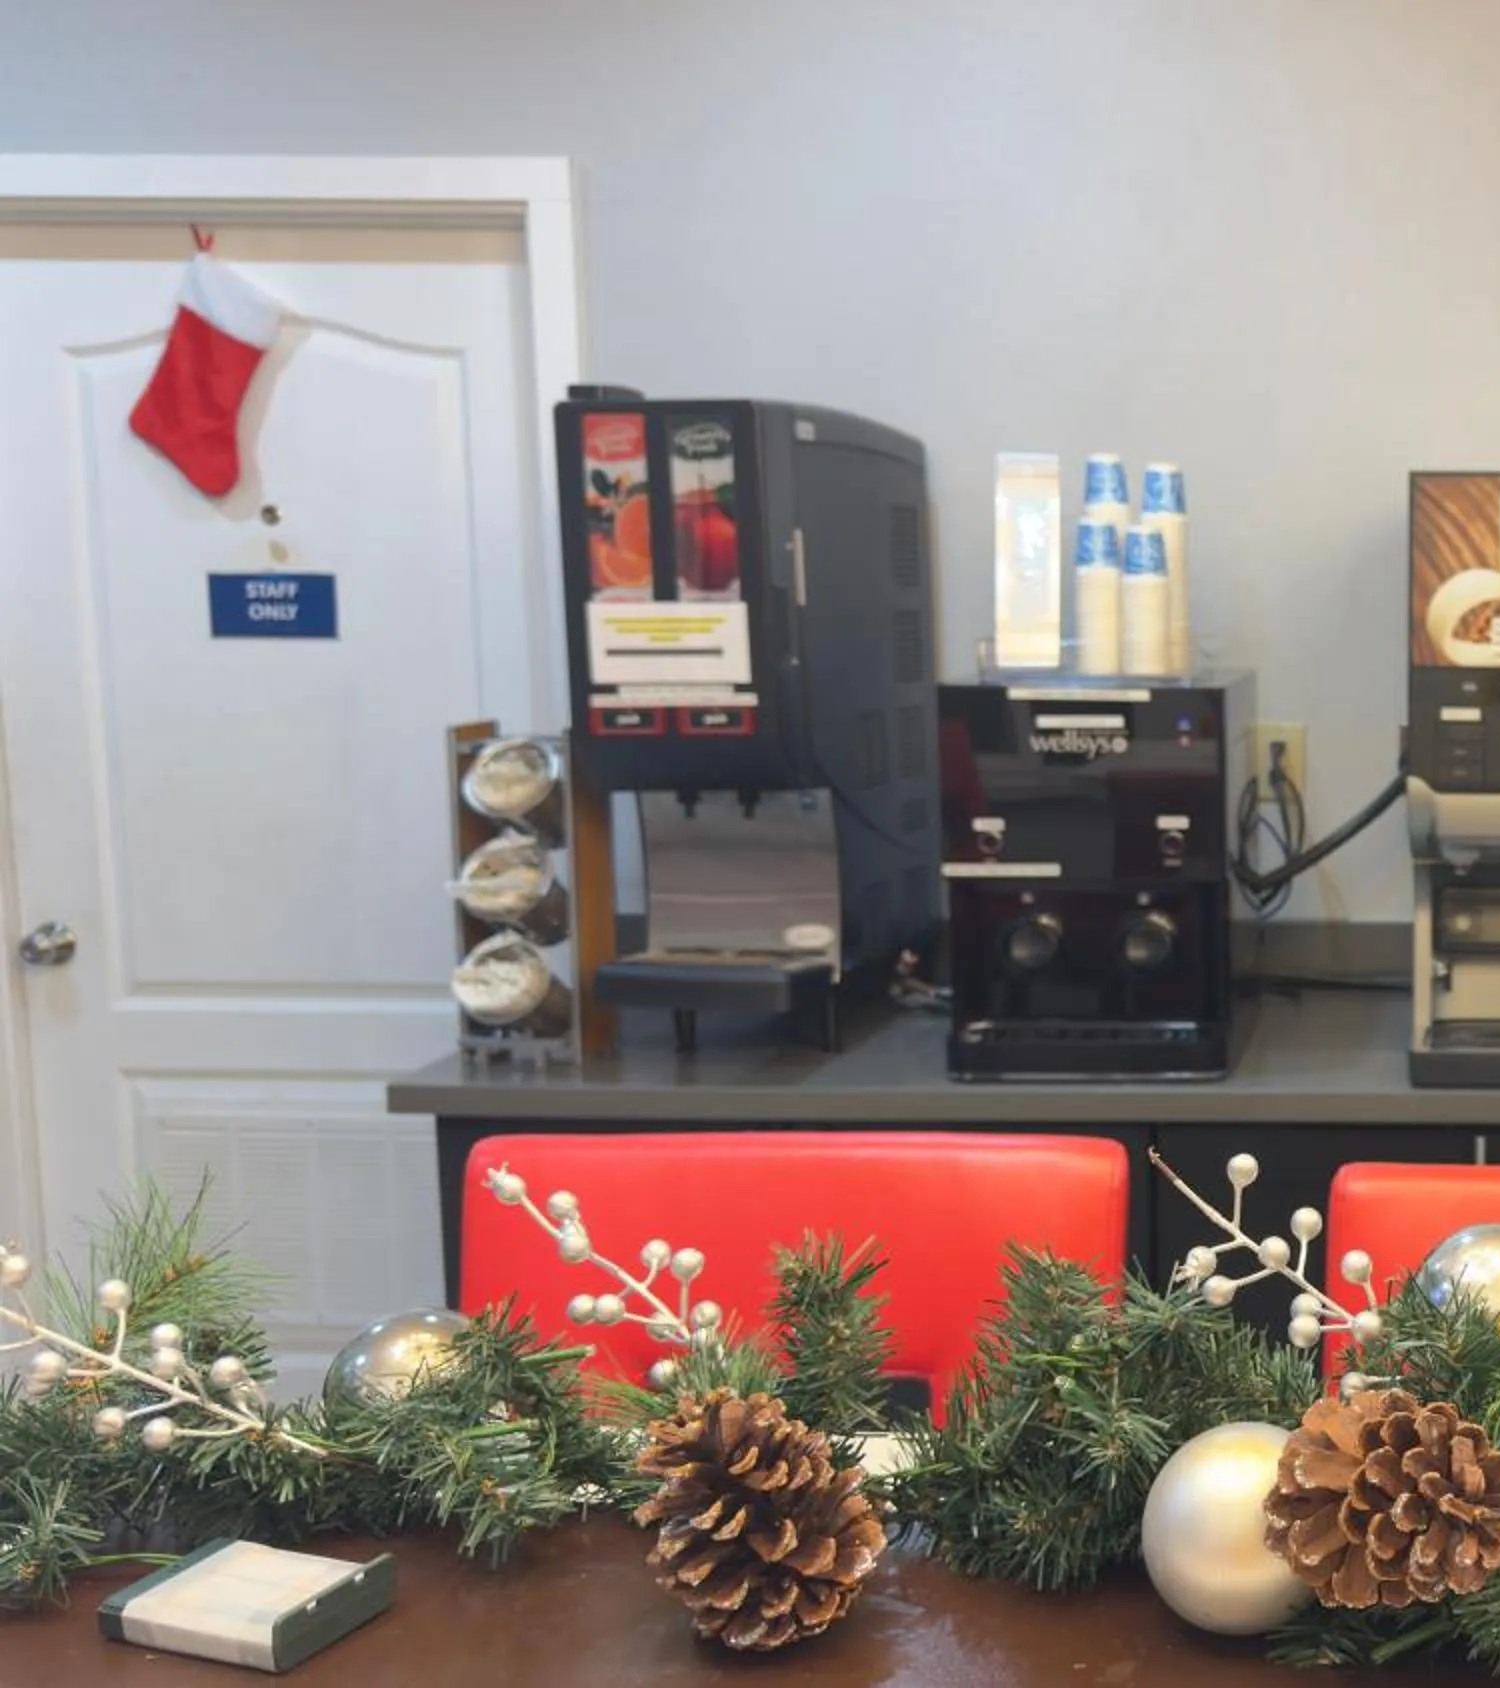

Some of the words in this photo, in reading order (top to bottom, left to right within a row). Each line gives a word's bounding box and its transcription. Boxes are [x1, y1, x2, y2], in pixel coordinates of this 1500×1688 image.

[245, 580, 299, 599] STAFF
[248, 602, 299, 621] ONLY
[1029, 729, 1112, 761] wellsys
